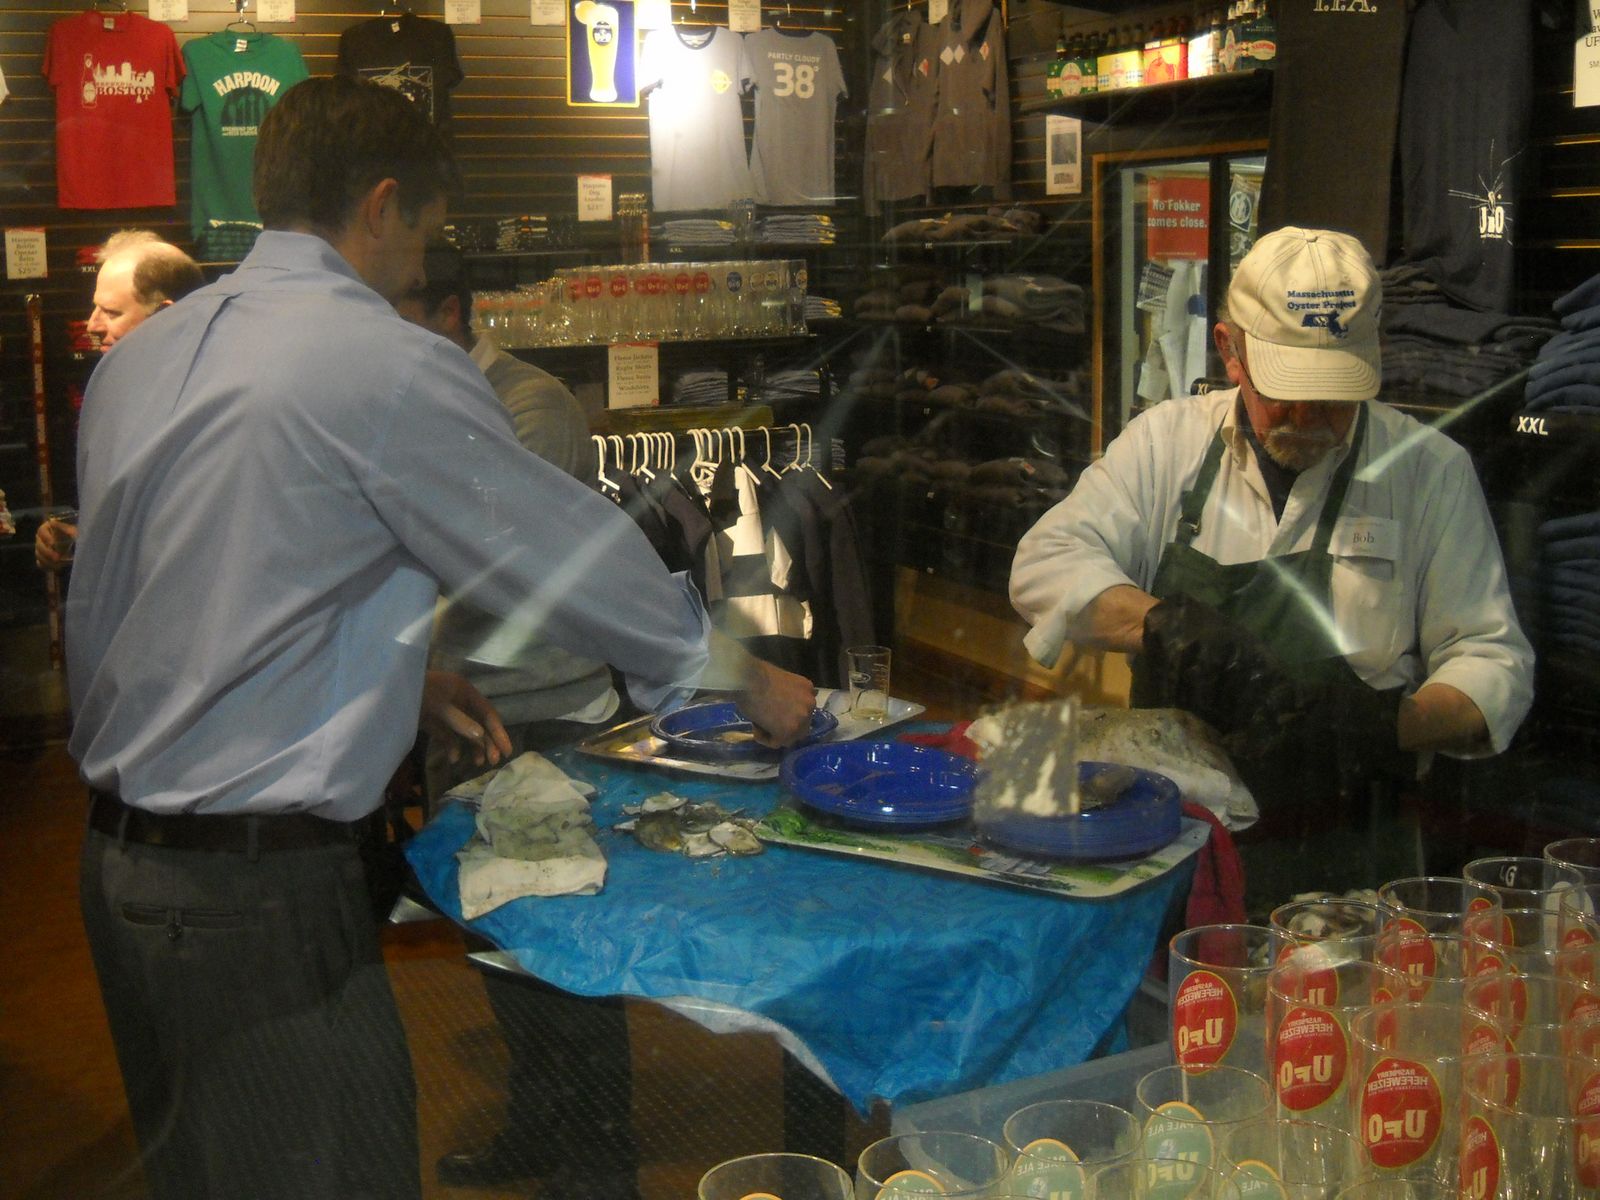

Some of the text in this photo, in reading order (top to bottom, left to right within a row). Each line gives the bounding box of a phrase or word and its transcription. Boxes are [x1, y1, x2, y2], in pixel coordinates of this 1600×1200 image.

[767, 52, 820, 63] PARTLY CLOUDY
[213, 71, 280, 96] HARPOON
[96, 86, 154, 96] BOSTON
[1152, 200, 1201, 212] No Fokker
[1147, 216, 1208, 228] comes close.
[1287, 290, 1355, 298] Massachusetts
[1287, 301, 1357, 312] Oyster Project
[1516, 415, 1549, 435] XXL
[1352, 532, 1375, 544] Bob
